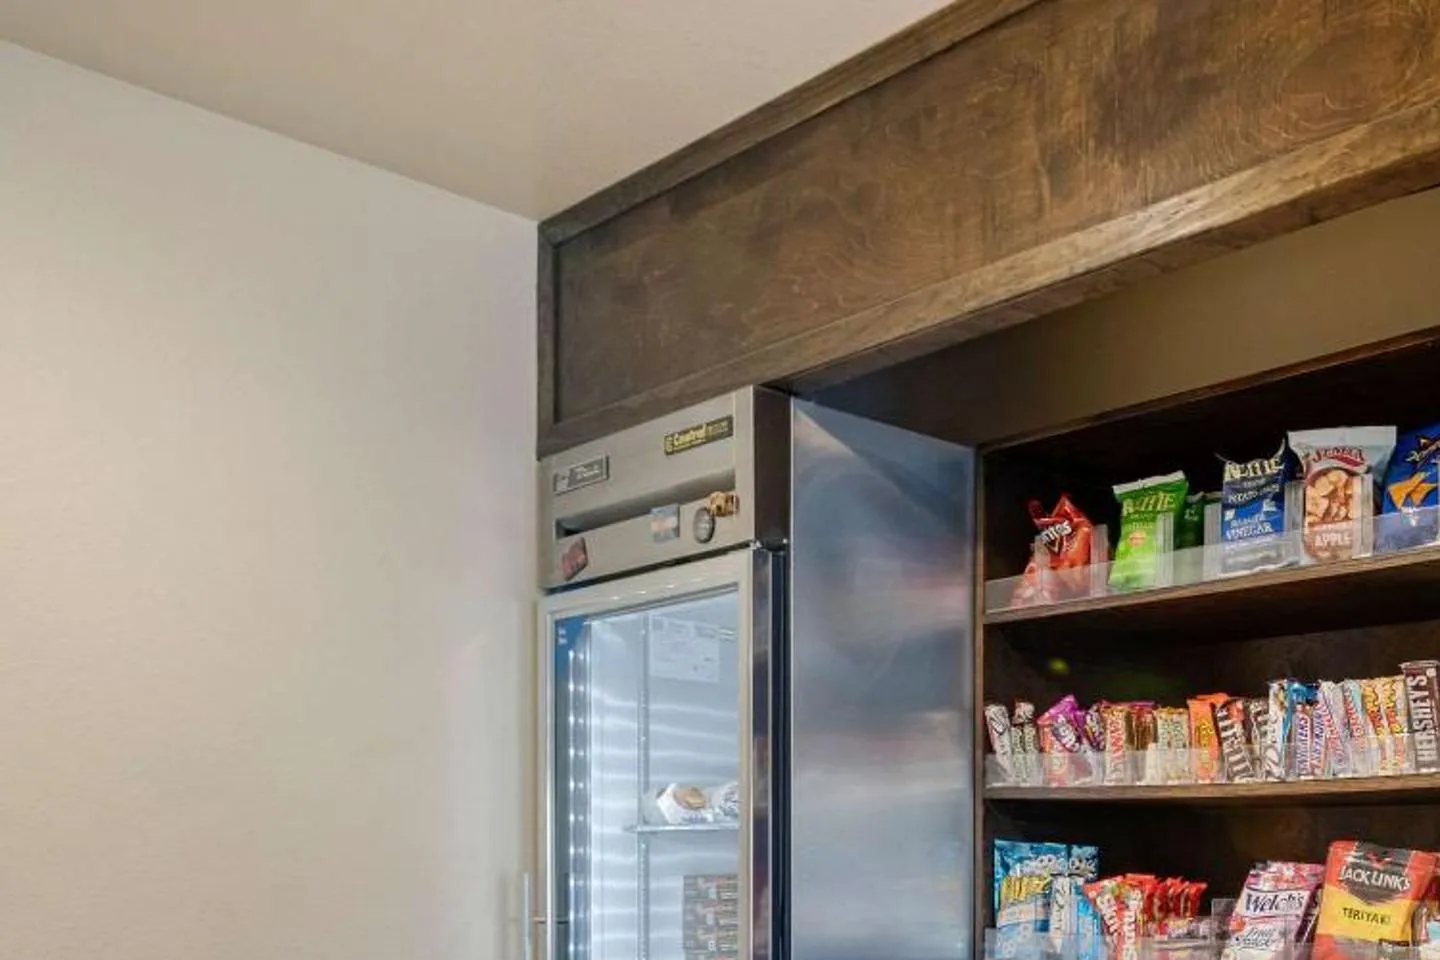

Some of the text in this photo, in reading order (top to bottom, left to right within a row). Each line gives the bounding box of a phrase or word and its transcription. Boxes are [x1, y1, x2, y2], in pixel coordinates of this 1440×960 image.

[1407, 674, 1439, 762] HERSHEY'S
[1340, 865, 1370, 886] JACK
[1245, 890, 1305, 913] Welch's
[1342, 906, 1392, 924] TERIYAKI
